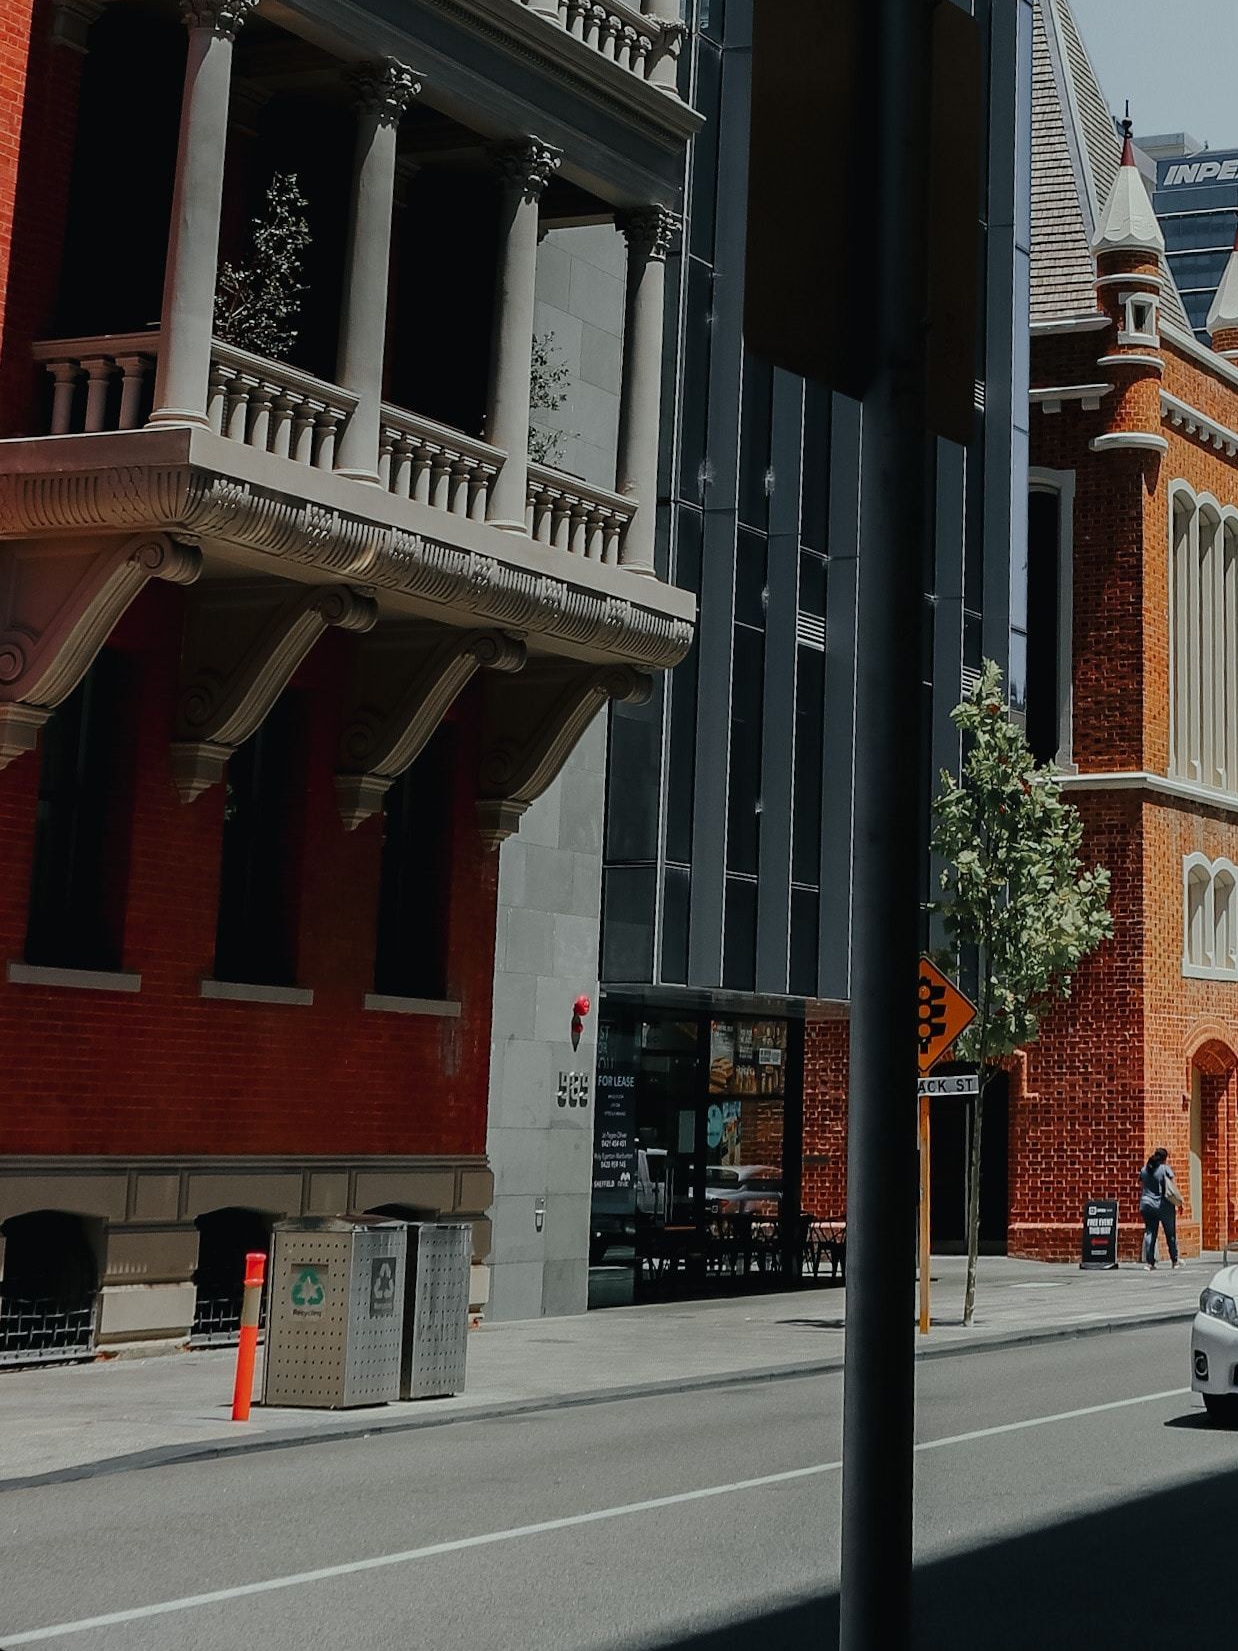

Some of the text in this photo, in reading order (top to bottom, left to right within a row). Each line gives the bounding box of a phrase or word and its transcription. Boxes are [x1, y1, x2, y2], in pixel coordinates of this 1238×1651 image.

[598, 1075, 635, 1087] FOR LEASE
[956, 1078, 973, 1093] ST
[292, 1309, 322, 1317] Recycling
